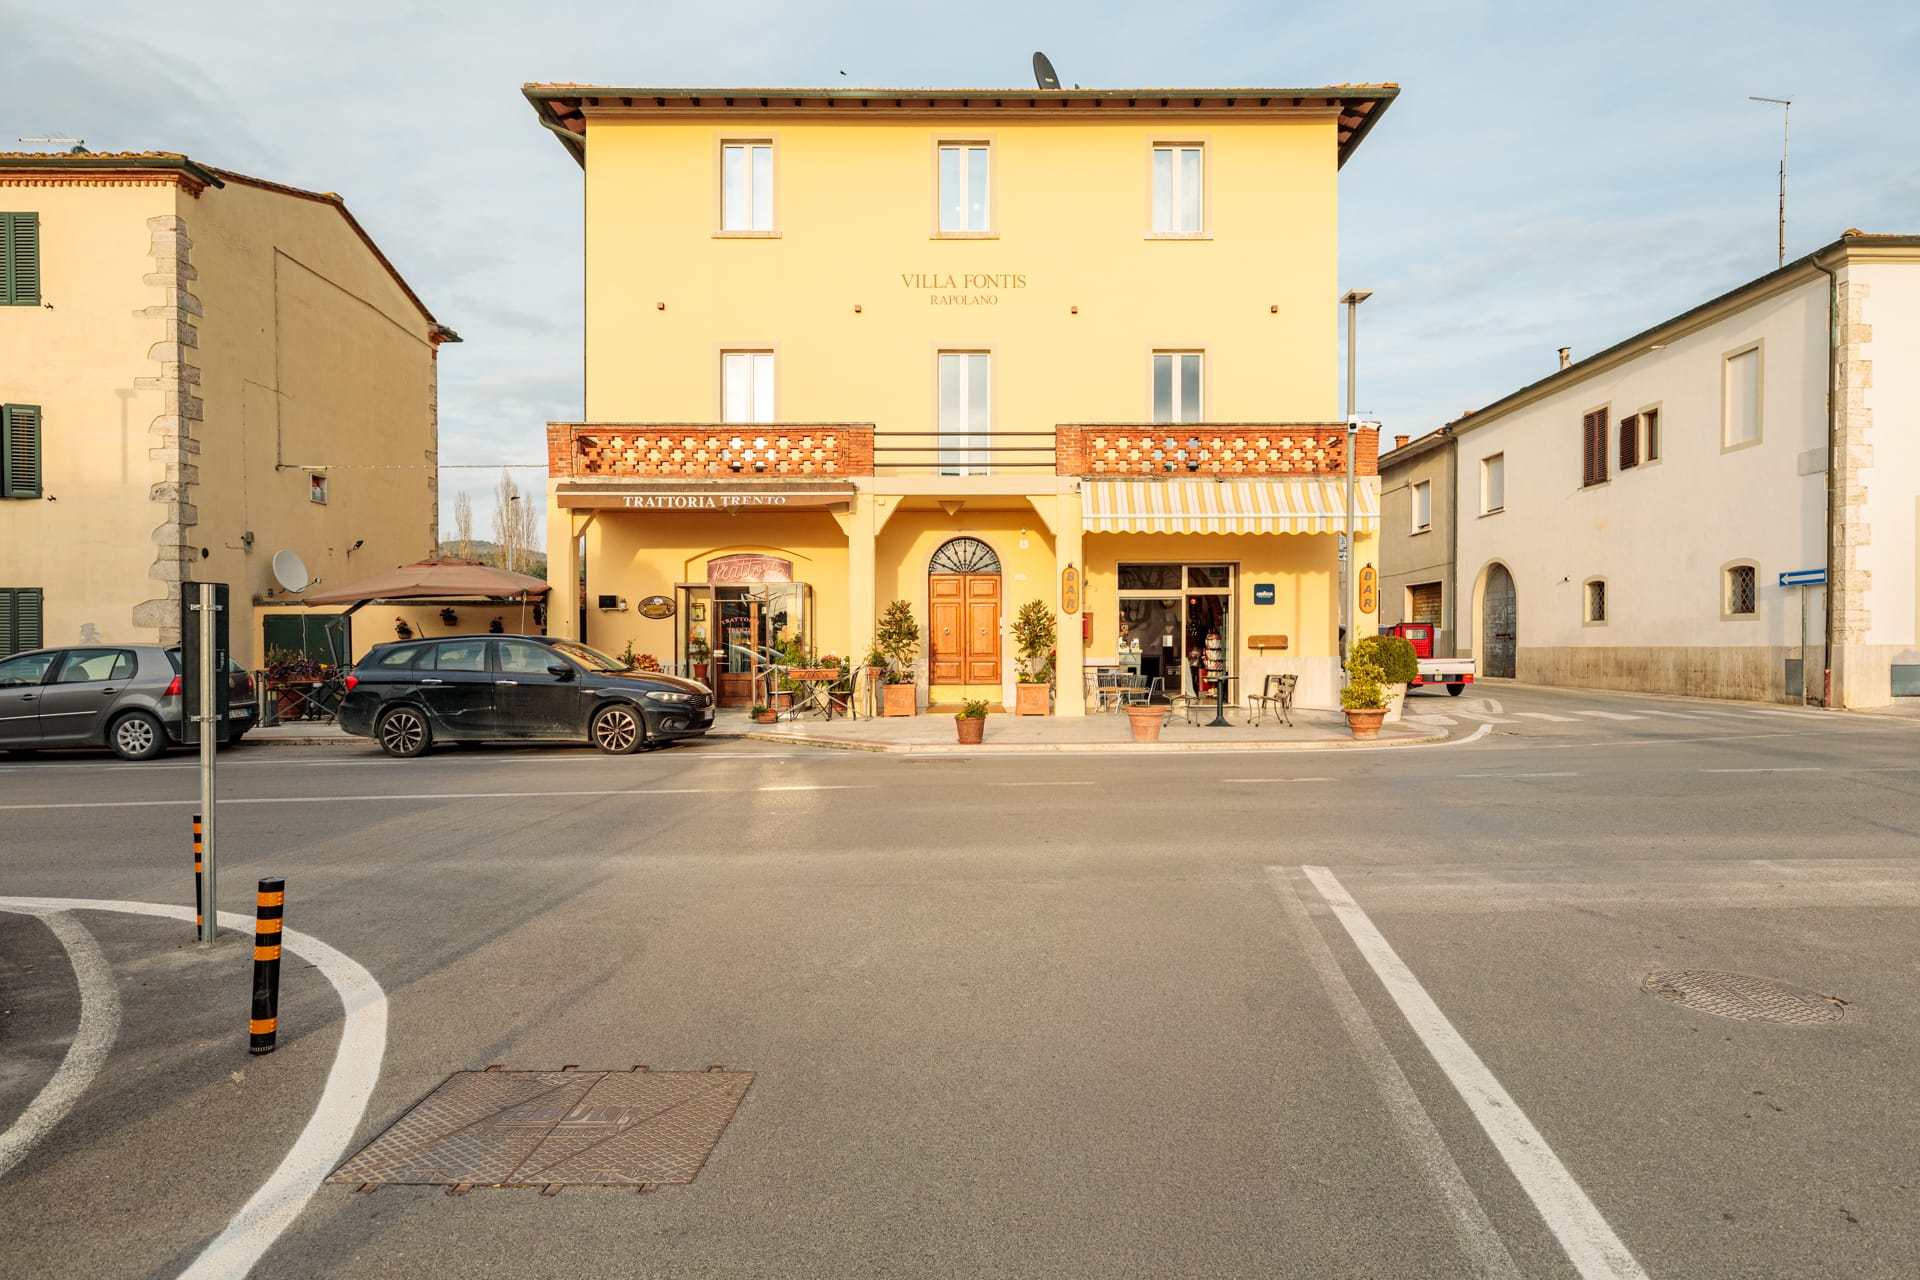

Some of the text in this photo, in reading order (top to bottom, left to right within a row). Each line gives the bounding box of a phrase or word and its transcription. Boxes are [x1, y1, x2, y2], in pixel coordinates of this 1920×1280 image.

[901, 273, 1027, 289] VILLA FONTIS
[930, 294, 998, 305] RAPOLANO
[623, 495, 787, 508] TRATTORIA TRENTO
[1066, 571, 1075, 609] BAR
[1363, 571, 1373, 608] BAR
